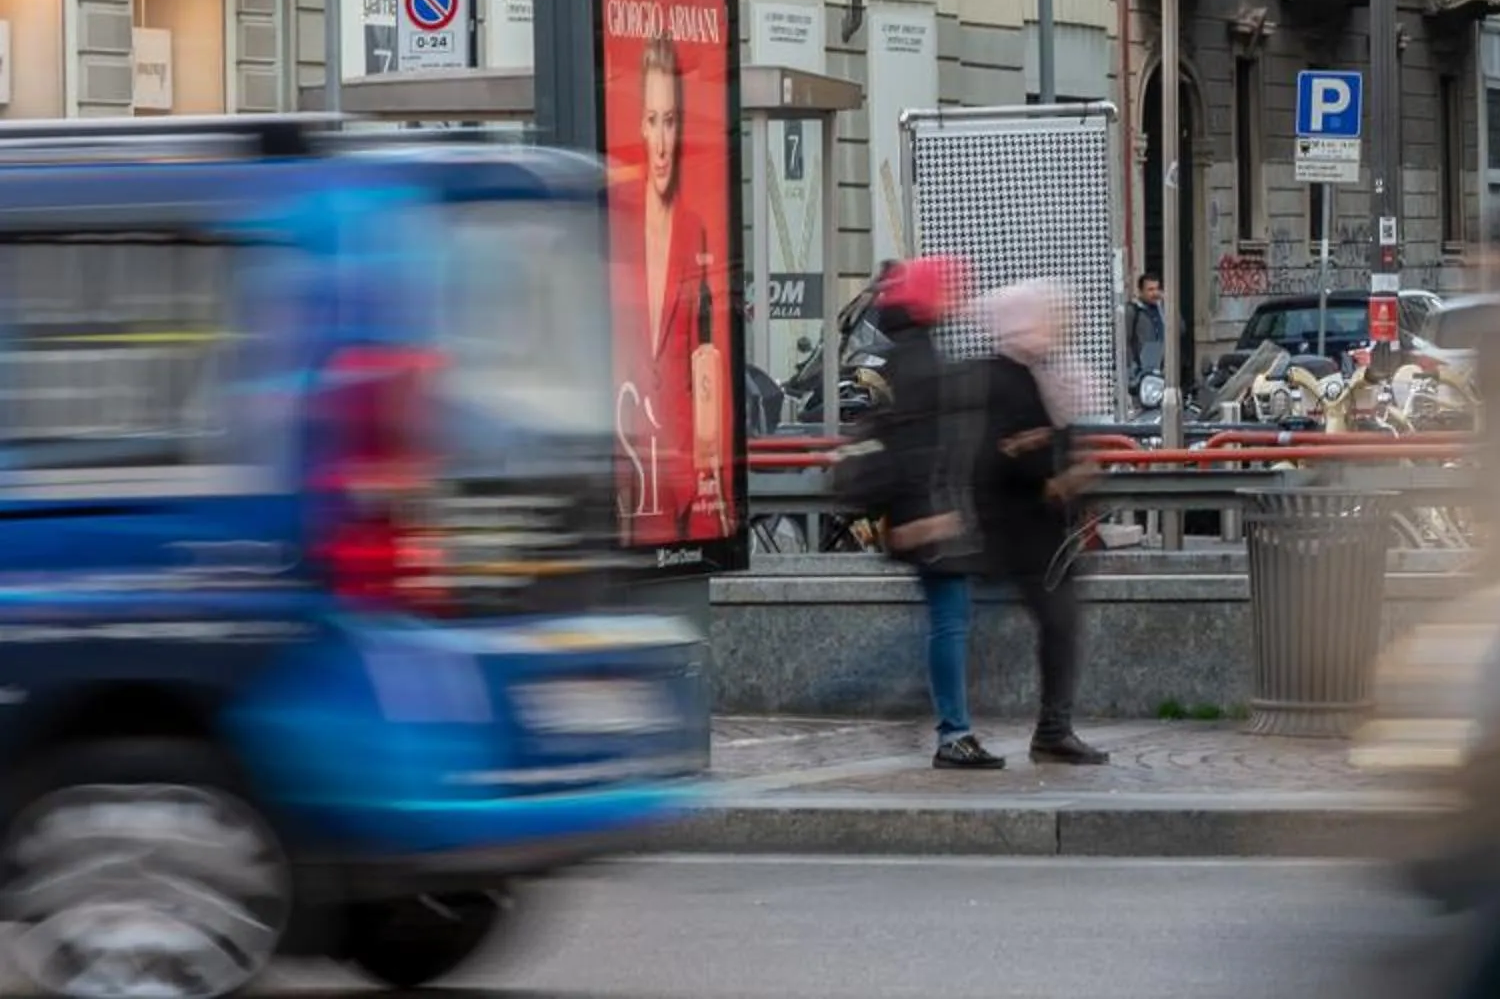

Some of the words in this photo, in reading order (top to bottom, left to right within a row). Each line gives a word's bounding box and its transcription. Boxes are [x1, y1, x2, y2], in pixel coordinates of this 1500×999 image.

[416, 36, 448, 48] 0-24
[607, 0, 663, 40] GIORGIO
[667, 4, 720, 44] ARMANI
[1310, 77, 1351, 132] P
